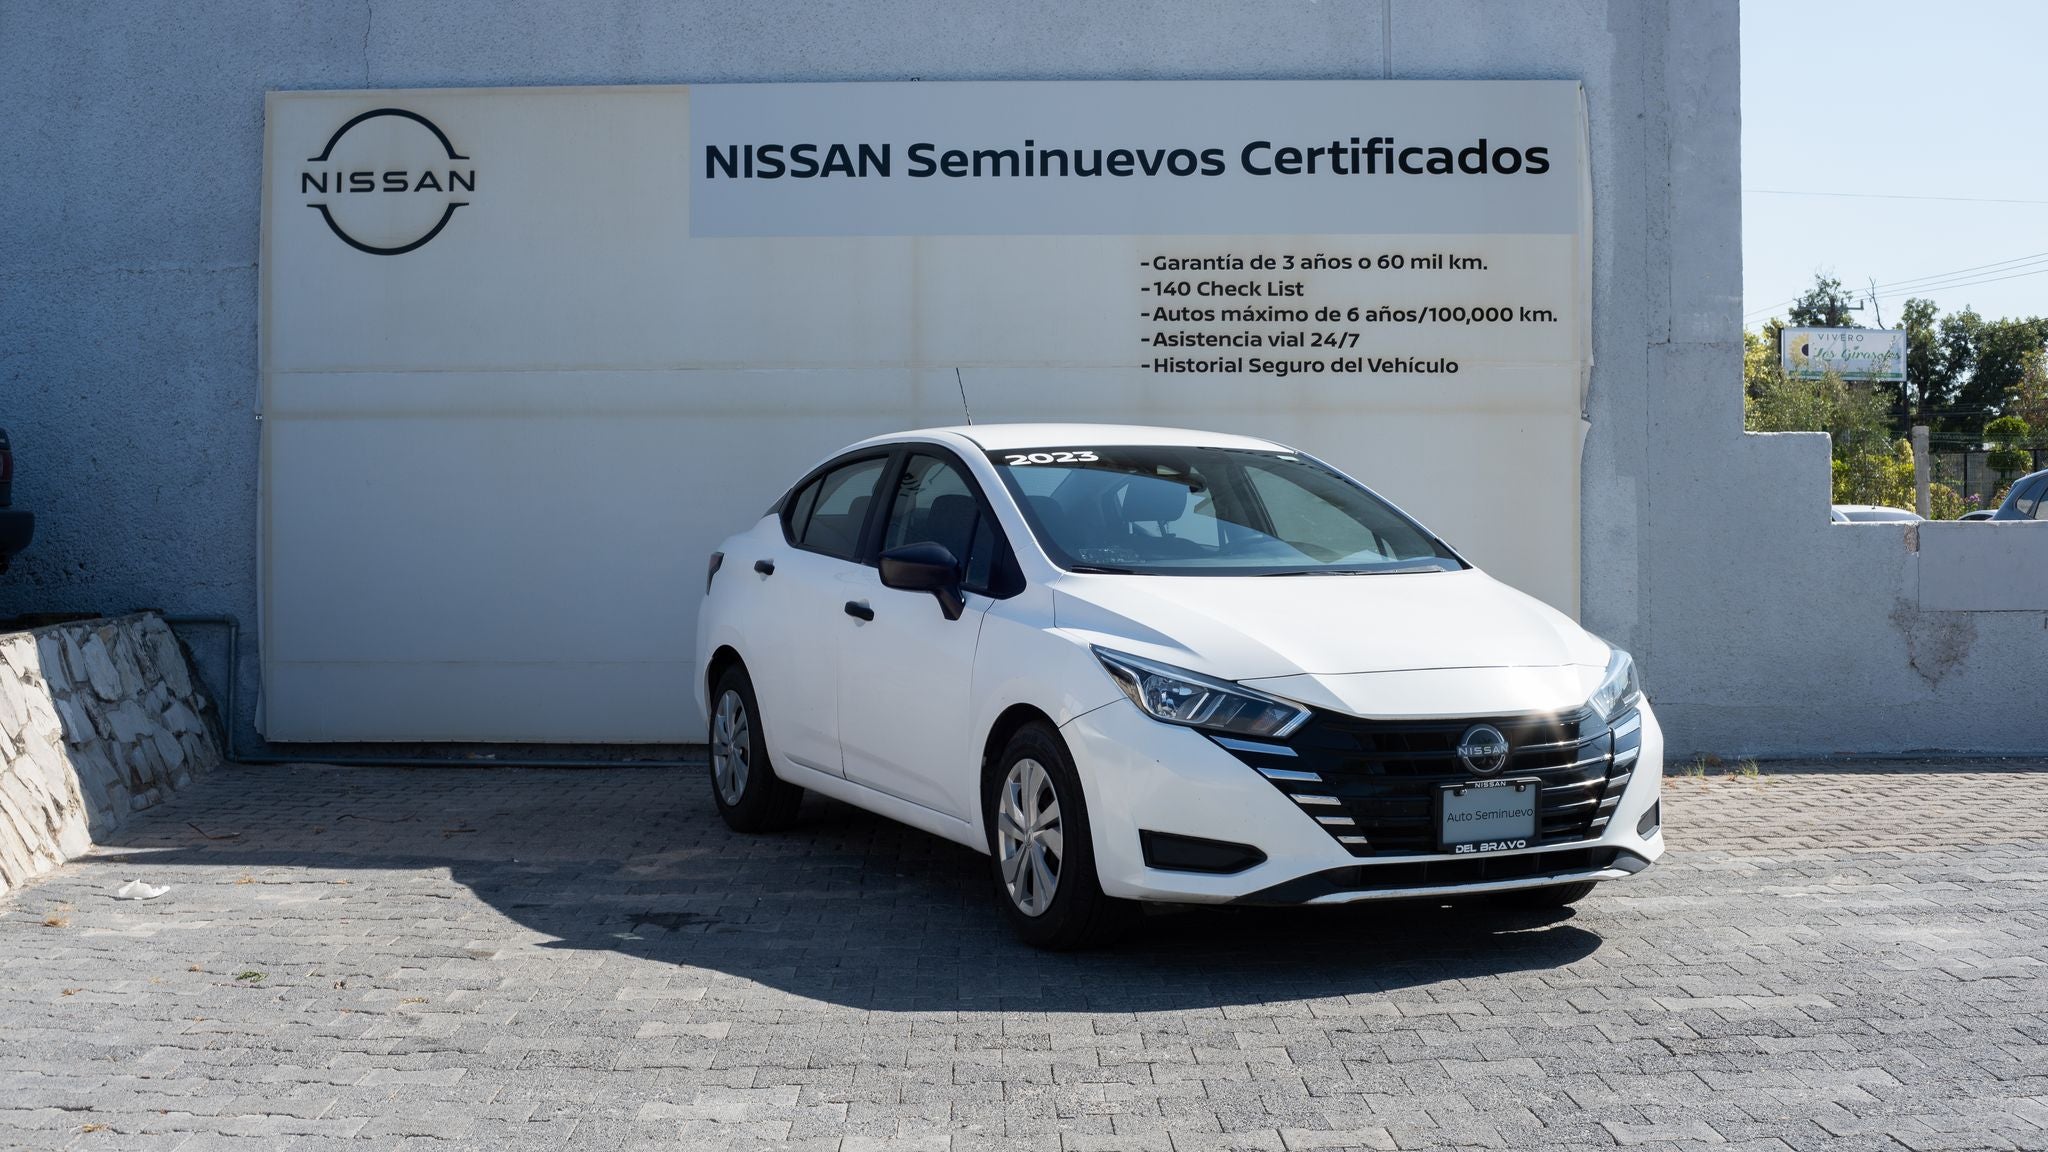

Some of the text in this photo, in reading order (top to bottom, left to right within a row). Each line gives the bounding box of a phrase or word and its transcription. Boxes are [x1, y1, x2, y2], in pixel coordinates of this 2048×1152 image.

[705, 136, 1550, 180] NISSAN Seminuevos Certificados
[301, 170, 476, 194] NISSAN
[1249, 254, 1277, 271] de
[1282, 255, 1295, 271] 3
[1300, 253, 1353, 270] años
[1357, 257, 1372, 270] o
[1377, 254, 1405, 270] 60
[1410, 253, 1443, 270] mil
[1449, 254, 1488, 270] km.
[1196, 280, 1262, 297] Check
[1267, 280, 1305, 297] List
[1221, 304, 1309, 322] máximo
[1314, 306, 1342, 322] de
[1346, 306, 1360, 322] 6
[1365, 305, 1514, 325] años/100,000
[1519, 306, 1558, 322] km.
[1267, 330, 1305, 348] vial
[1310, 331, 1361, 349] 24/7
[1817, 333, 1864, 342] VIVERO
[1248, 357, 1325, 377] Seguro
[1330, 356, 1363, 373] del
[1367, 356, 1459, 374] Vehículo
[1005, 450, 1099, 466] 2023
[1457, 743, 1509, 756] NISSAN
[1474, 780, 1506, 789] NISSAN
[1446, 808, 1534, 823] Auto Seminuevo
[1455, 840, 1526, 854] DEL BRAVO
